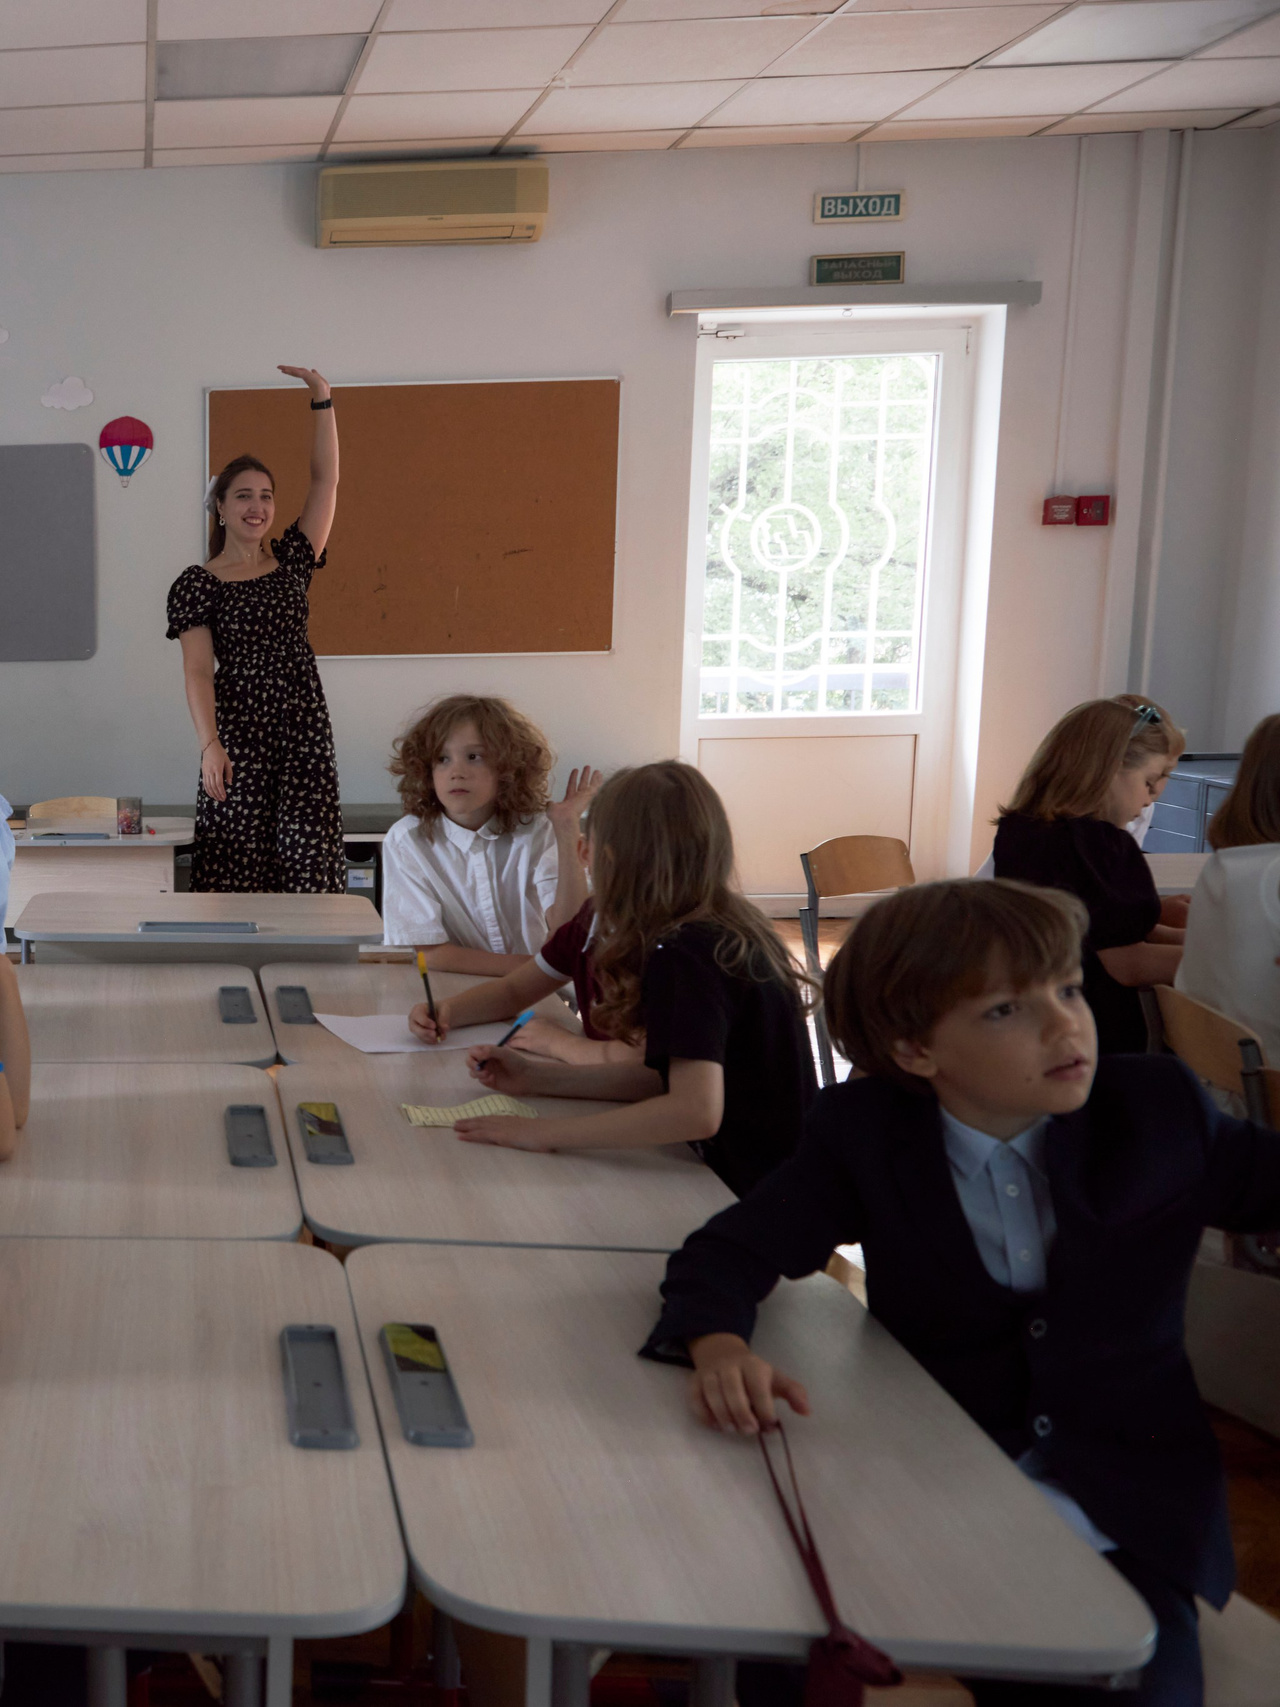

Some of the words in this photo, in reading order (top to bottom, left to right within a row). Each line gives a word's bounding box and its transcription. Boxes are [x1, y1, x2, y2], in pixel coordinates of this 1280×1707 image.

[824, 197, 896, 216] ВЫХОД
[821, 257, 897, 270] ЗАПАСНЫЙ
[832, 269, 883, 280] ВЫХОД
